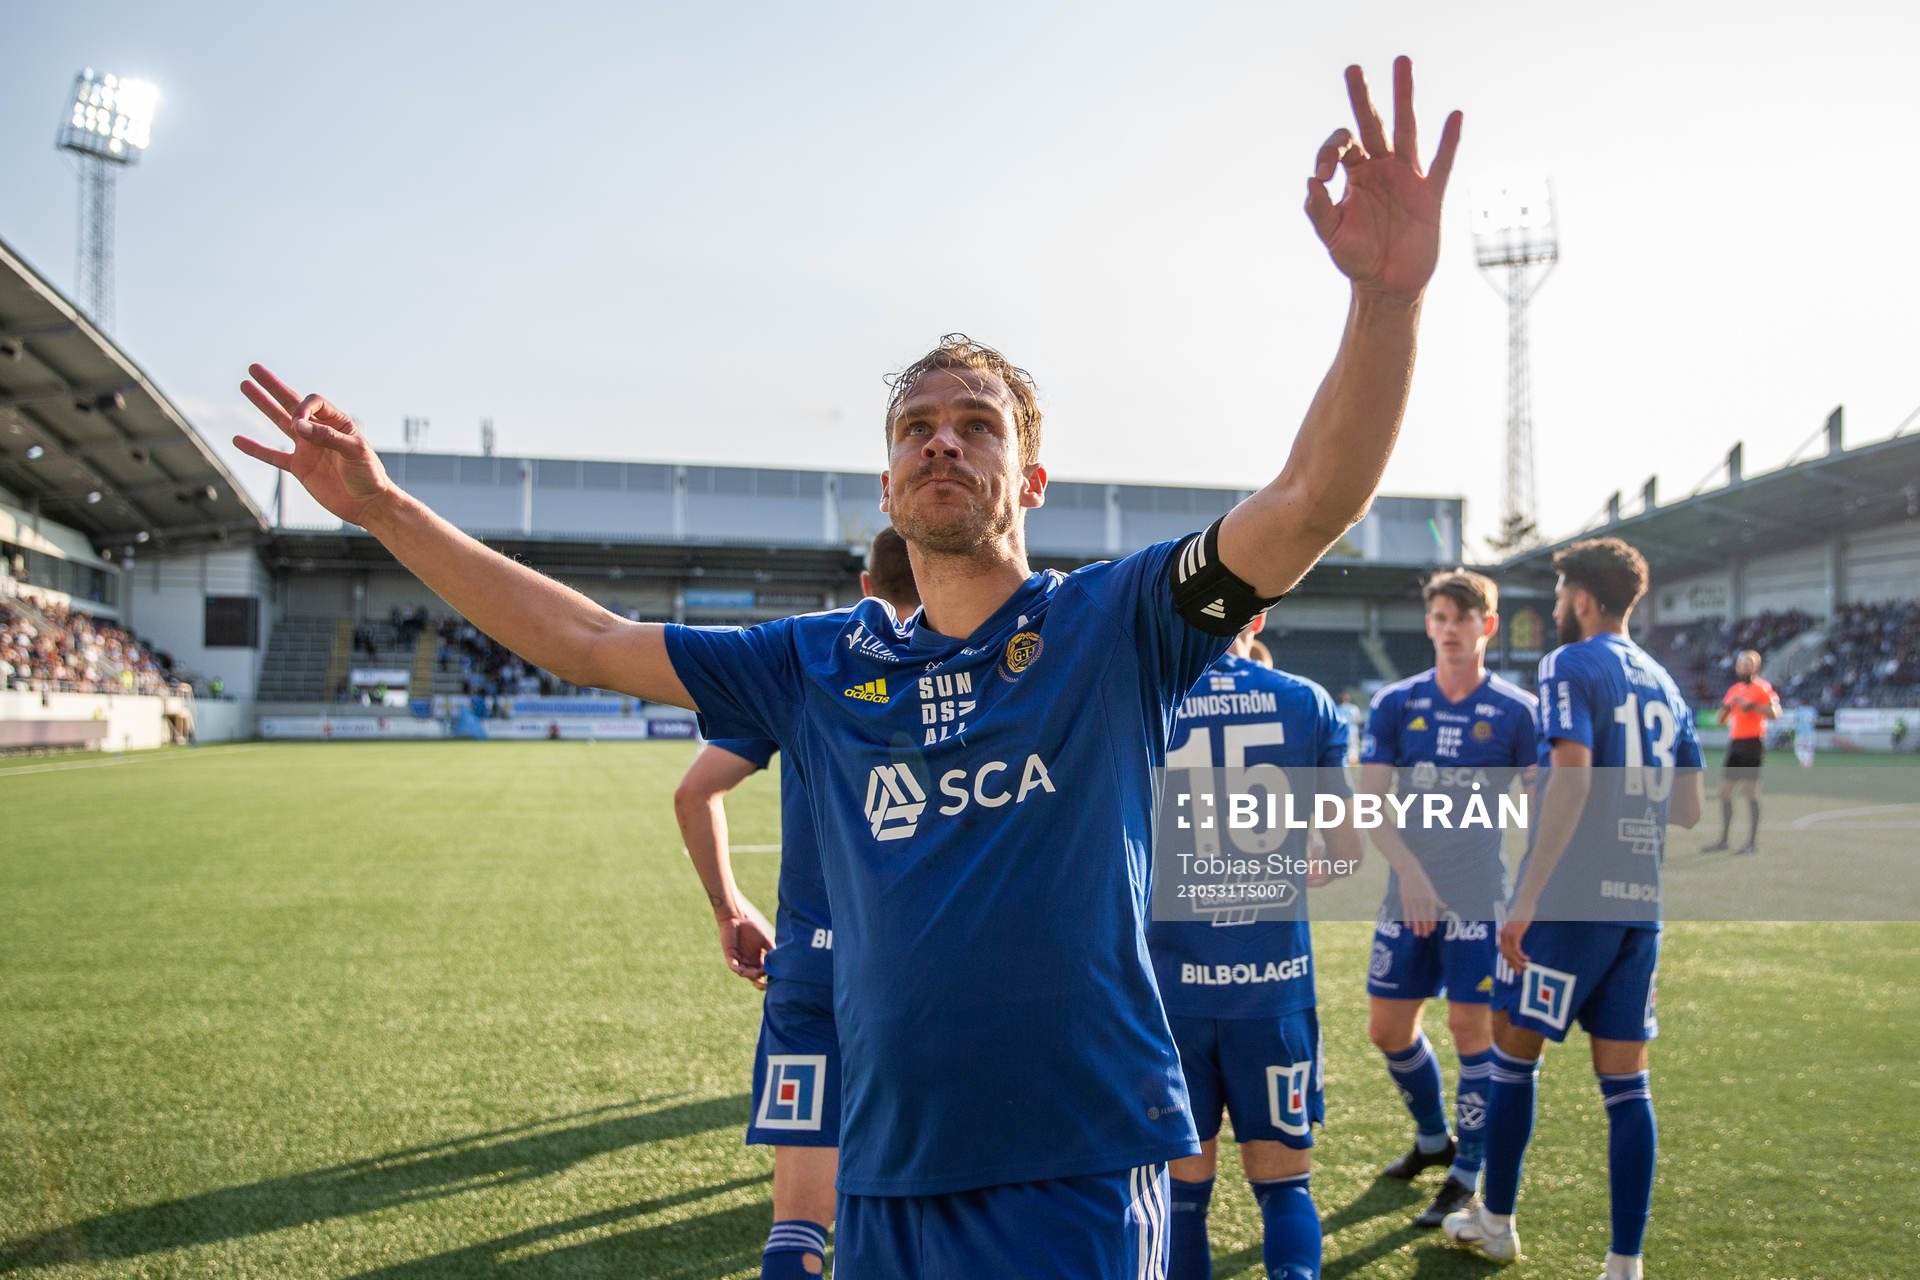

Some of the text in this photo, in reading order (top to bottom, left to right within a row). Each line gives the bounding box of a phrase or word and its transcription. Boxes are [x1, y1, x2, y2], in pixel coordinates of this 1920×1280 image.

[844, 688, 890, 704] adidas
[918, 671, 972, 699] SUN
[1179, 690, 1277, 719] LUNDSTRÖM
[1614, 692, 1675, 802] 13
[939, 754, 1056, 816] SCA
[1166, 722, 1292, 859] 15
[1440, 767, 1490, 787] SCA
[1181, 955, 1309, 985] BILBOLAGET
